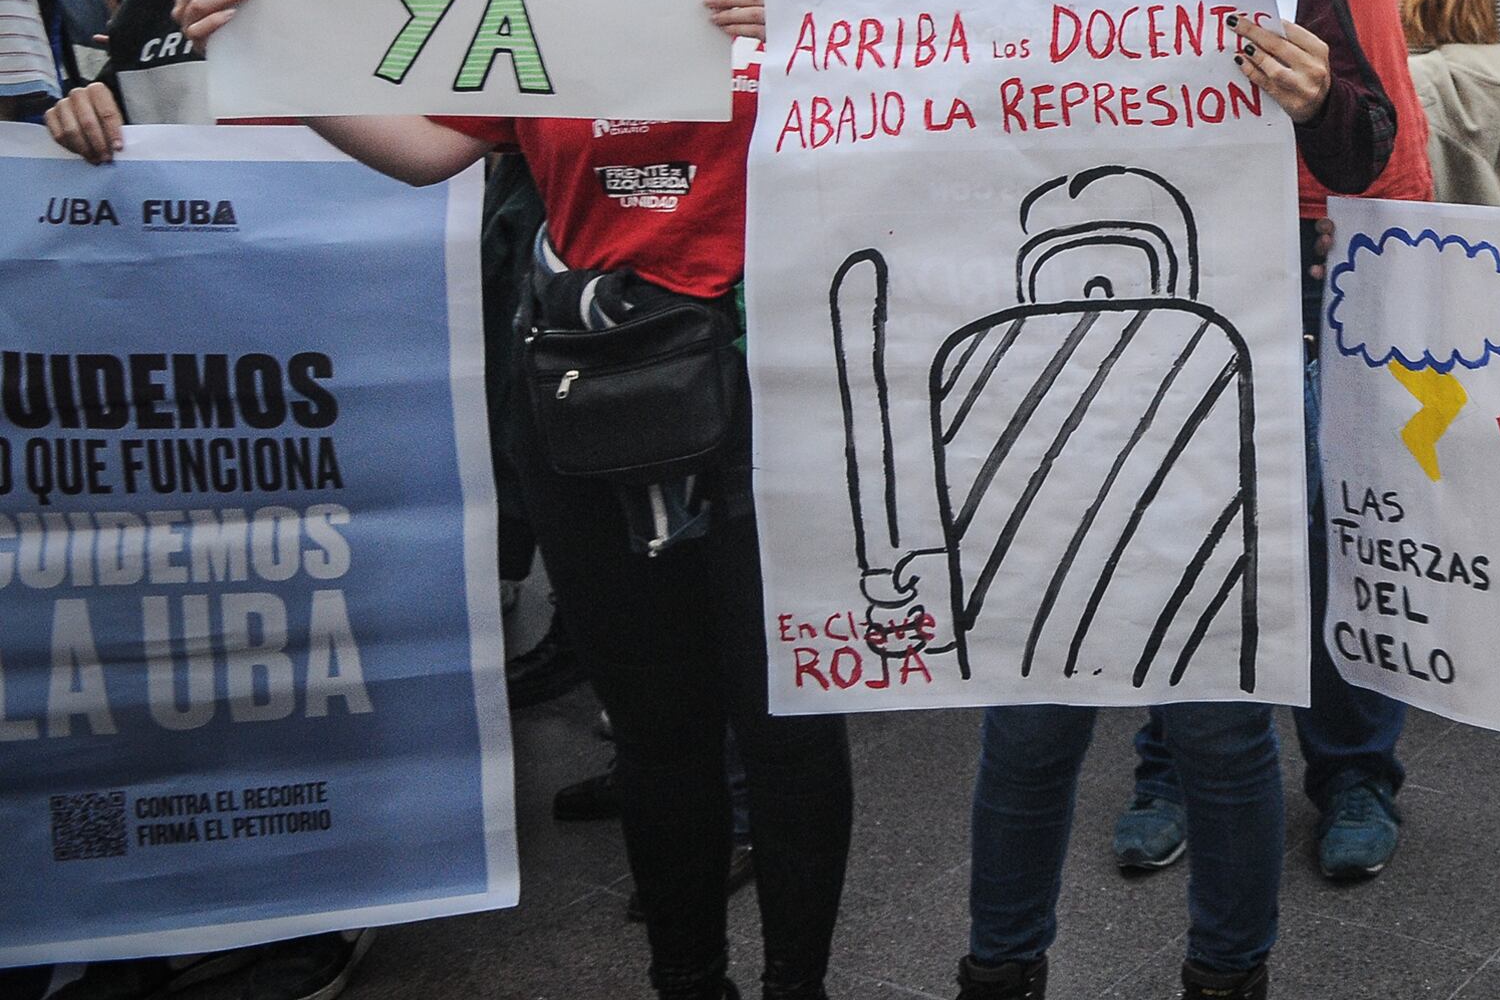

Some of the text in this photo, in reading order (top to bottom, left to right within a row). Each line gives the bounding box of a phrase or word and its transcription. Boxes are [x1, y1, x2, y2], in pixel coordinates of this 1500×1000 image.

[786, 9, 971, 75] ARRIBA
[993, 38, 1030, 60] LOS
[775, 76, 1262, 153] ABAJO LA REPRESION
[606, 164, 669, 178] FRENTE
[142, 199, 237, 225] FUBA
[2, 351, 339, 430] UIDEMOS
[26, 438, 112, 505] QUE
[121, 437, 343, 494] FUNCIONA
[1341, 479, 1403, 524] LAS
[1332, 517, 1490, 590] FUERZAS
[1354, 577, 1429, 624] DEL
[141, 589, 374, 731] UBA
[793, 646, 932, 691] ROJA
[1334, 620, 1456, 685] CIELO
[135, 781, 328, 819] CONTRA EL RECORTE
[204, 819, 228, 841] EL
[232, 809, 331, 838] PETITORIO
